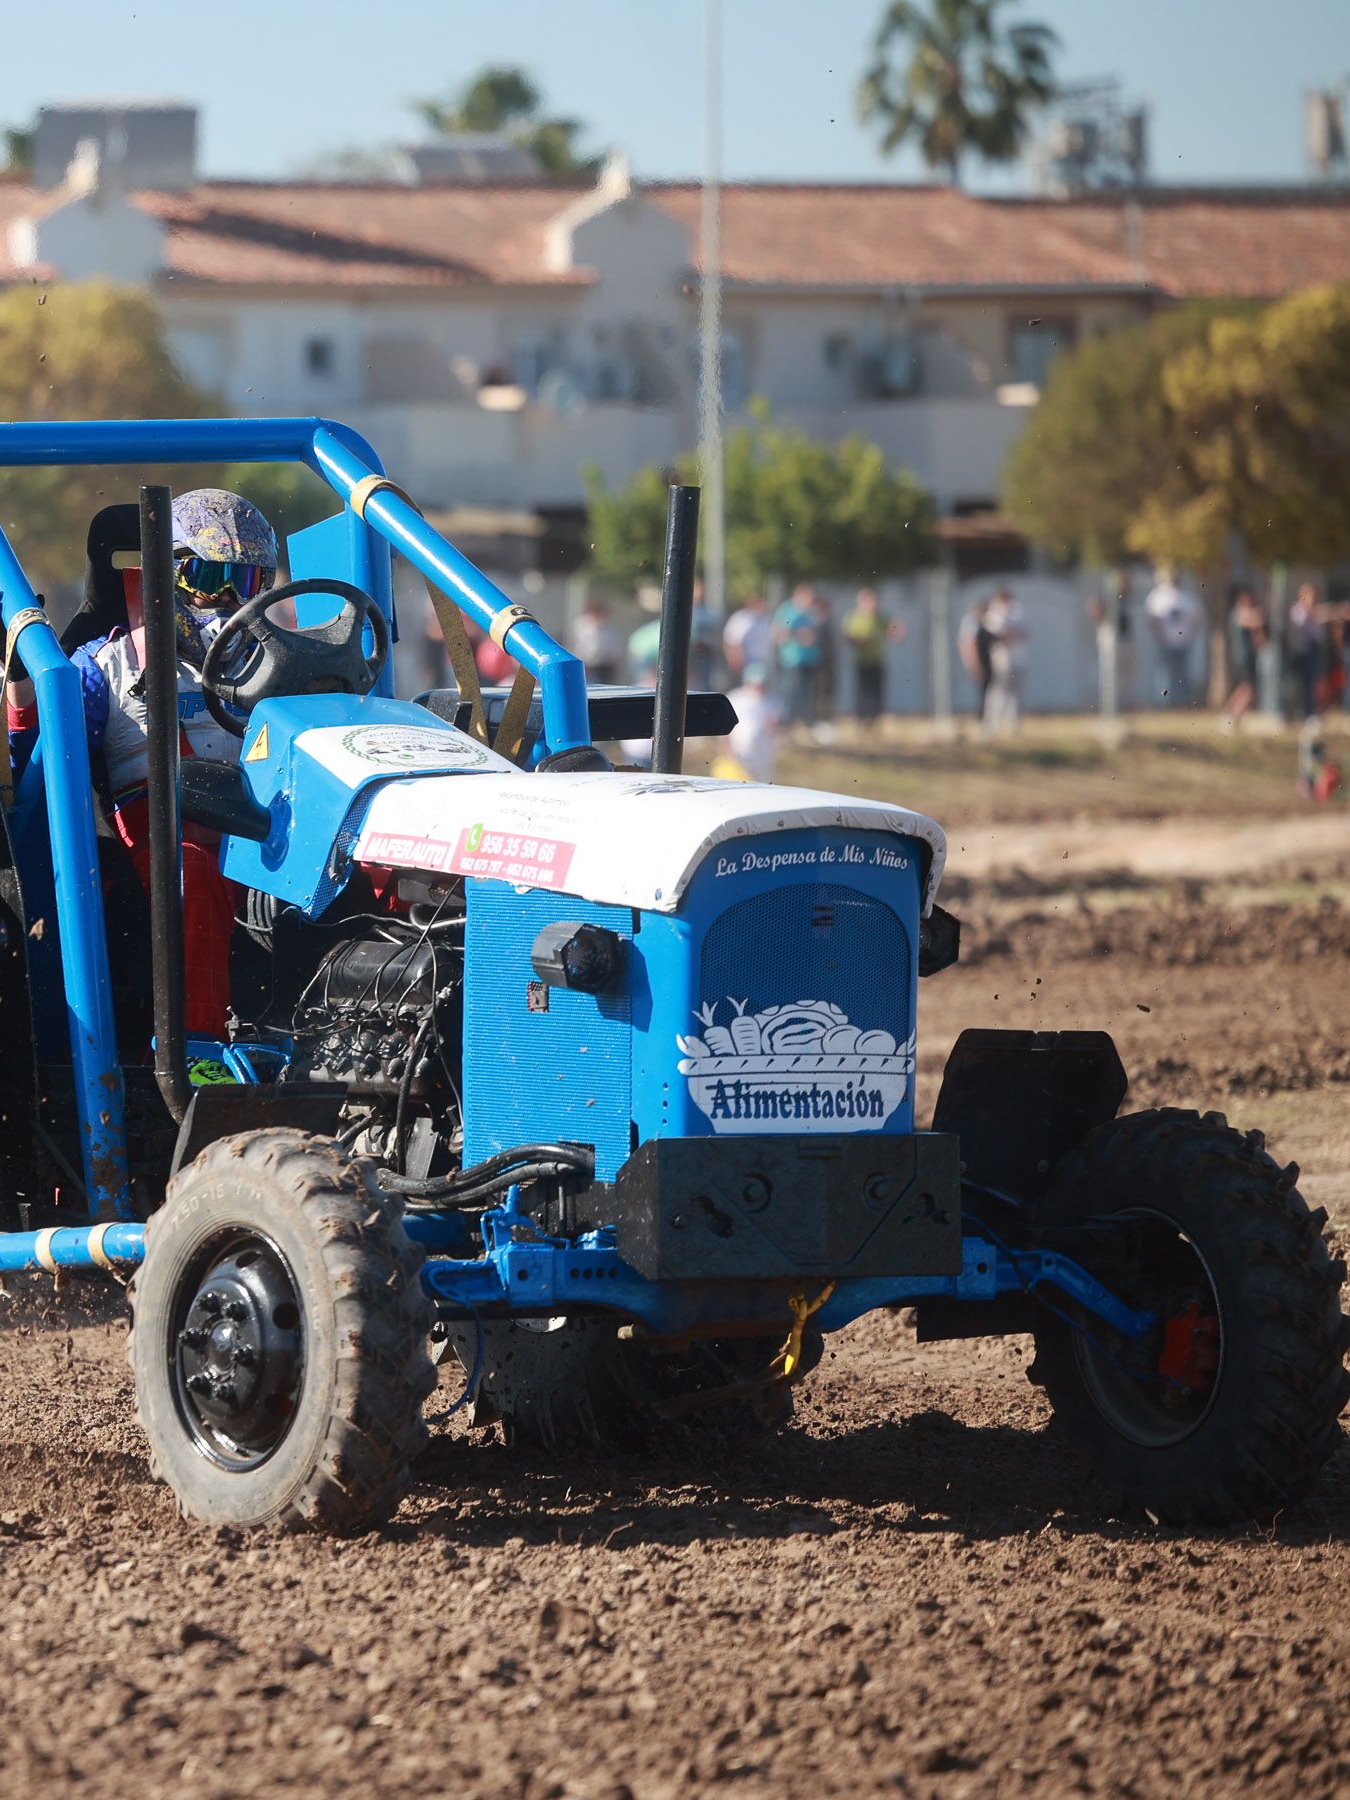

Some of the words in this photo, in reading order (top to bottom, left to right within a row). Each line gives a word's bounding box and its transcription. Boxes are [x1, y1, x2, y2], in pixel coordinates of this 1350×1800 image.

[480, 836, 504, 853] 956
[504, 838, 521, 857] 35
[521, 839, 538, 859] 59
[538, 843, 556, 863] 66
[715, 857, 737, 877] La
[742, 851, 816, 872] Despensa
[820, 846, 836, 863] de
[838, 844, 865, 864] Mis
[869, 847, 909, 870] Niños
[710, 1075, 884, 1119] Alimentación
